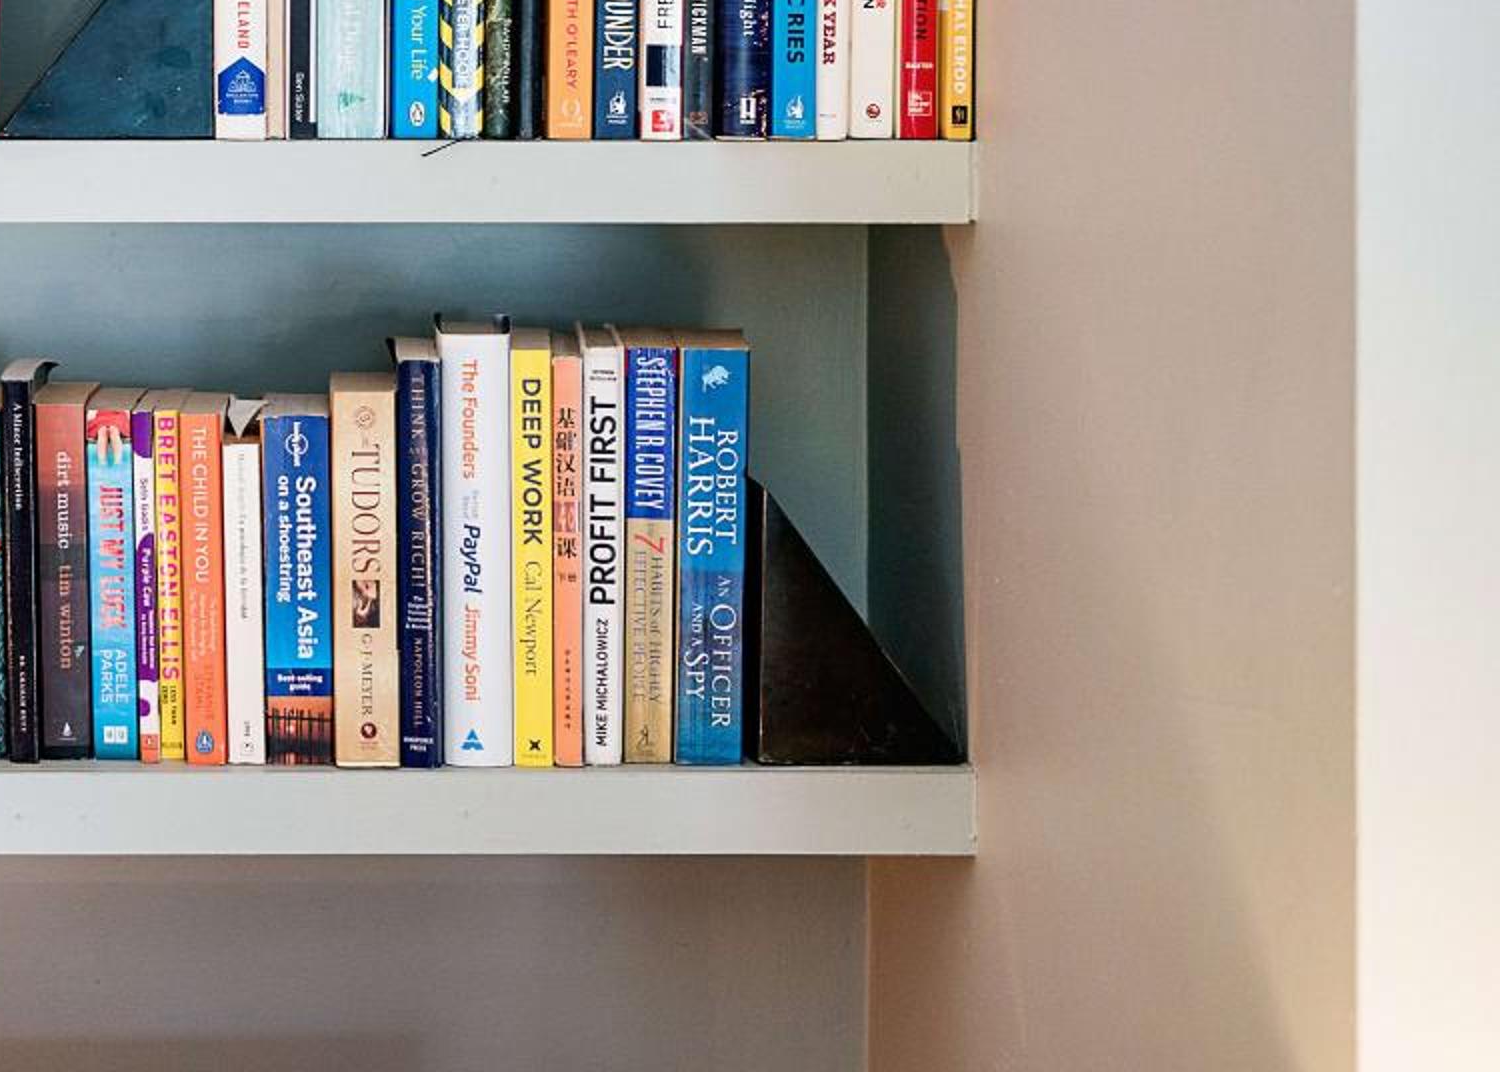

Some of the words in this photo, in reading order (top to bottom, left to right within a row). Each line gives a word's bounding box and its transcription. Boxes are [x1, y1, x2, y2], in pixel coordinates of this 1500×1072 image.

[411, 5, 428, 45] Your
[787, 12, 806, 63] RIES
[822, 12, 837, 64] YEAR
[411, 49, 428, 81] Life
[953, 35, 967, 94] ELROD
[461, 359, 479, 393] The
[635, 356, 665, 429] STEPHEN
[410, 376, 425, 440] THINK
[522, 378, 543, 449] DEEP
[158, 416, 177, 481] BRET
[192, 427, 207, 459] THE
[462, 397, 481, 479] Founders
[590, 395, 617, 481] FIRST
[57, 451, 72, 487] dirt
[192, 463, 208, 518] CHILD
[278, 475, 289, 497] on
[411, 462, 426, 520] GROW
[634, 454, 665, 510] COVEY
[686, 415, 715, 556] HARRIS
[715, 429, 739, 545] ROBERT
[57, 493, 73, 549] music
[99, 484, 124, 532] JUST
[278, 500, 288, 510] a
[351, 443, 381, 574] TUDORS
[523, 458, 543, 545] WORK
[100, 538, 125, 569] MY
[160, 495, 179, 598] EASTON
[193, 523, 208, 543] IN
[276, 515, 292, 603] shoestring
[295, 475, 317, 600] Southeast
[460, 523, 483, 593] PayPal
[589, 494, 616, 605] PROFIT
[634, 533, 665, 555] 7
[59, 564, 74, 597] tim
[141, 547, 152, 584] Purple
[194, 545, 210, 584] YOU
[524, 560, 543, 591] Cal
[650, 556, 663, 617] HABITS
[100, 574, 127, 629] LUCK
[691, 602, 703, 633] AND
[60, 603, 75, 670] winton
[162, 608, 181, 680] ELLIS
[297, 606, 319, 659] Asia
[461, 603, 481, 659] Jimmy
[520, 598, 542, 677] Newport
[100, 649, 114, 703] PARKS
[114, 649, 129, 703] ADELE
[413, 638, 423, 697] NAPOLEON
[464, 664, 482, 701] Soni
[596, 618, 609, 711] MICHALOWICZ
[649, 640, 663, 704] HIGHLY
[596, 715, 609, 747] MIKE
